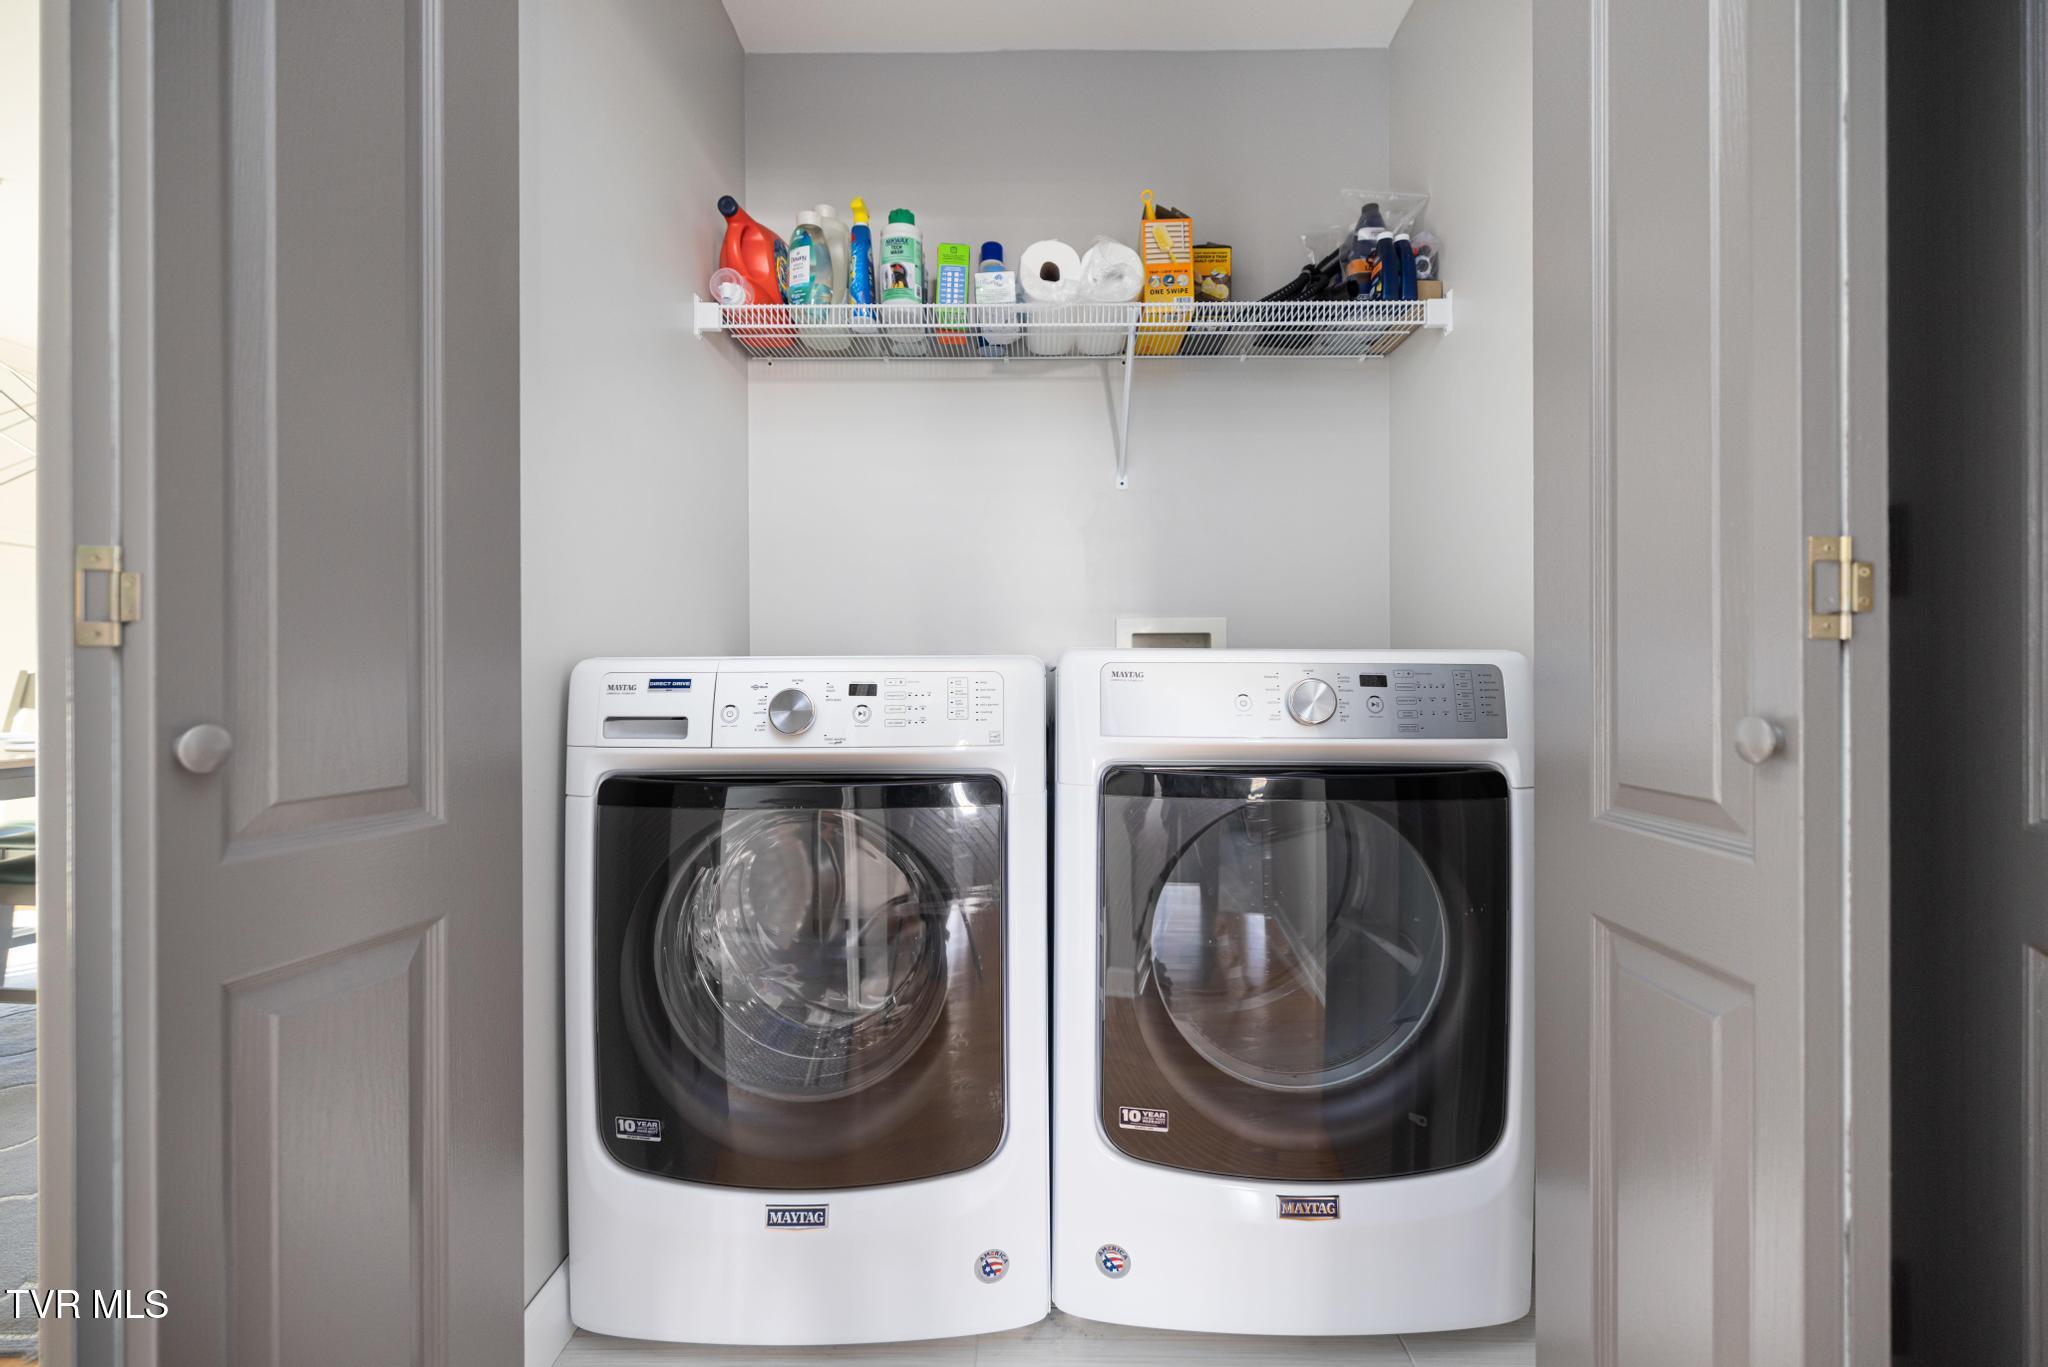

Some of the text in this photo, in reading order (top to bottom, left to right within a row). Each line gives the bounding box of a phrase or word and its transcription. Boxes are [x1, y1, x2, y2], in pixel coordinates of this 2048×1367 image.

[1166, 287, 1189, 295] SWIPE
[1122, 1109, 1166, 1122] 10 YEAR
[618, 1119, 636, 1132] 10
[1281, 1202, 1336, 1214] MAYTAG
[769, 1211, 824, 1224] MAYTAG
